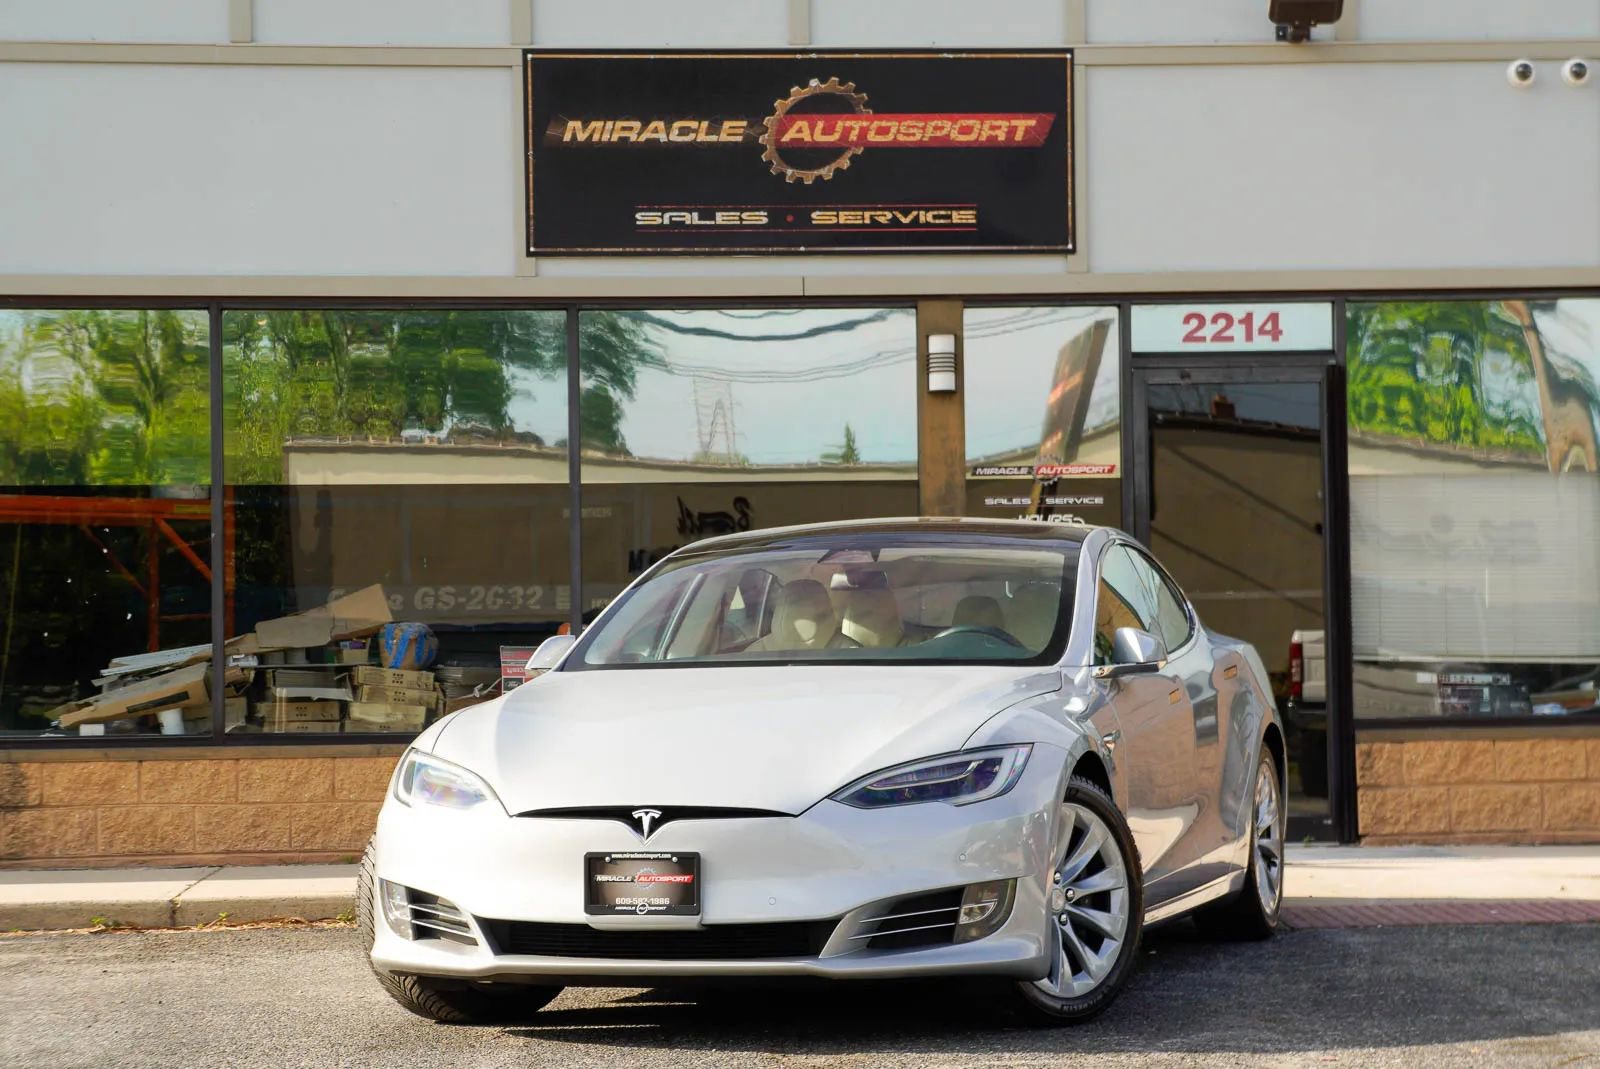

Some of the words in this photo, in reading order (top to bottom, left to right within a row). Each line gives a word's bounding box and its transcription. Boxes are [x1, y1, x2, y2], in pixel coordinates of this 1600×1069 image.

[562, 120, 748, 143] MIRACLE
[780, 118, 1037, 143] AUTOSPORT
[634, 211, 769, 226] SALES
[810, 209, 977, 225] SERVICE
[1182, 311, 1283, 343] 2214
[975, 466, 1029, 475] MIRACLE
[1038, 465, 1112, 475] AUTOSPORT
[984, 497, 1032, 505] SALES
[1045, 496, 1104, 505] SERVICE
